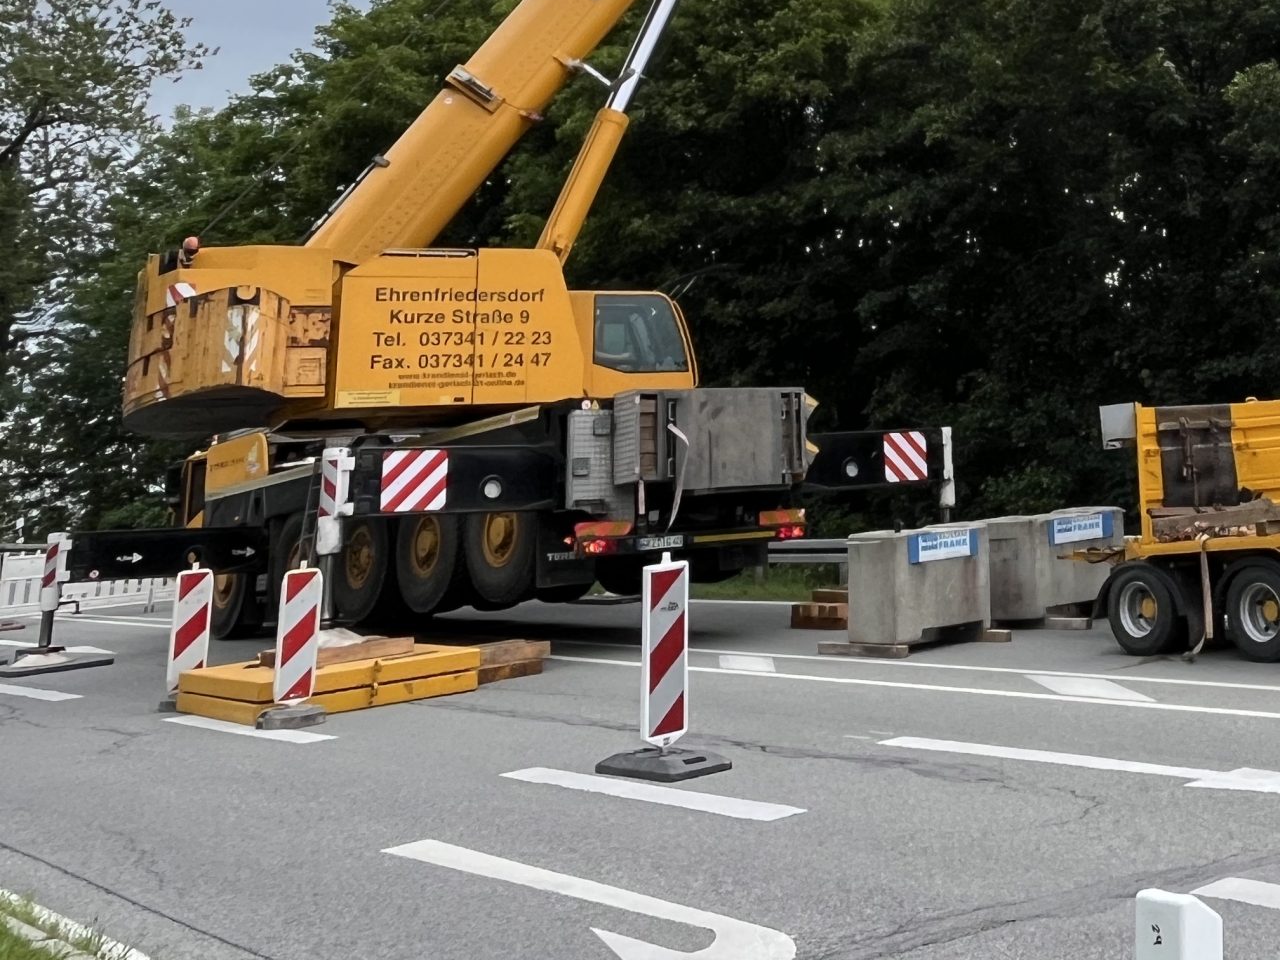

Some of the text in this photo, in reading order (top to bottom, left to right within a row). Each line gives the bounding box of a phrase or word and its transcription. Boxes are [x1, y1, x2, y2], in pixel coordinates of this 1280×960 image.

[375, 287, 545, 302] Ehrenfriedersdorf
[390, 309, 530, 324] Kurze Straße 9
[373, 330, 552, 347] Tel. 037341 / 22 23
[370, 352, 552, 370] Fax. 037341 / 24 47
